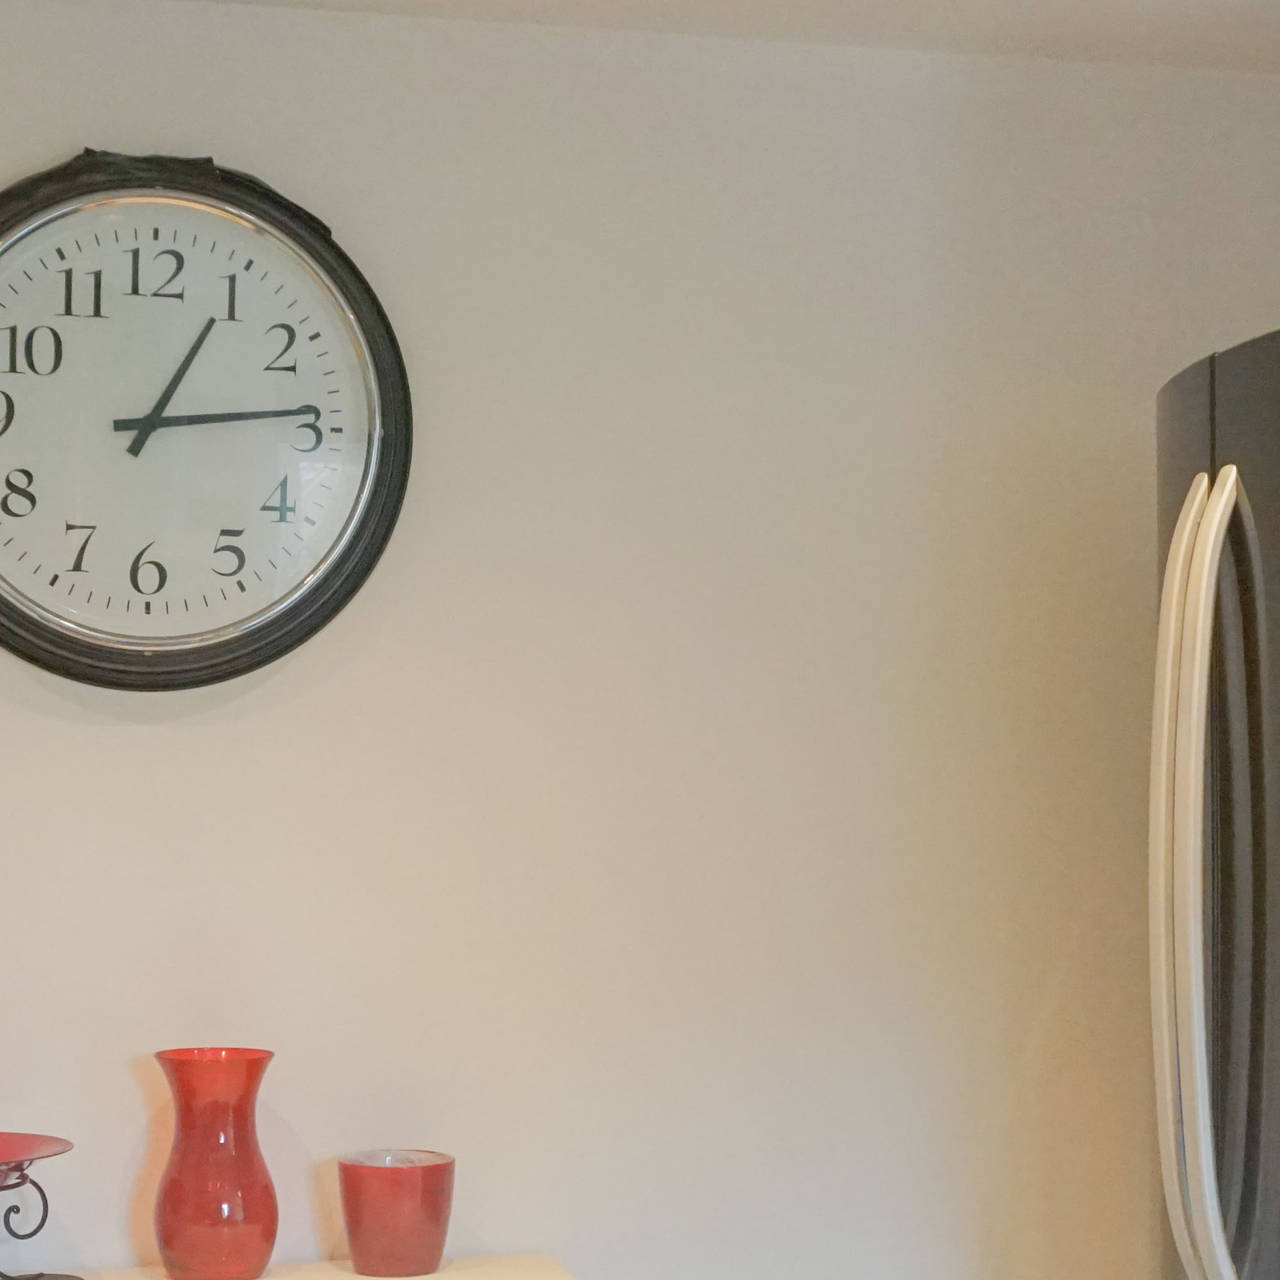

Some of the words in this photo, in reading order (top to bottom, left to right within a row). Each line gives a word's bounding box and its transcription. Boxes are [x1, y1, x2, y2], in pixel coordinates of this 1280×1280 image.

[56, 268, 110, 318] 11
[122, 248, 184, 302] 12
[220, 274, 243, 321] 1
[0, 325, 62, 375] 10
[264, 324, 296, 376] 2
[289, 404, 322, 451] 3
[0, 468, 36, 516] 8
[260, 474, 296, 523] 4
[65, 521, 96, 572] 7
[130, 541, 167, 594] 6
[211, 528, 246, 576] 5
